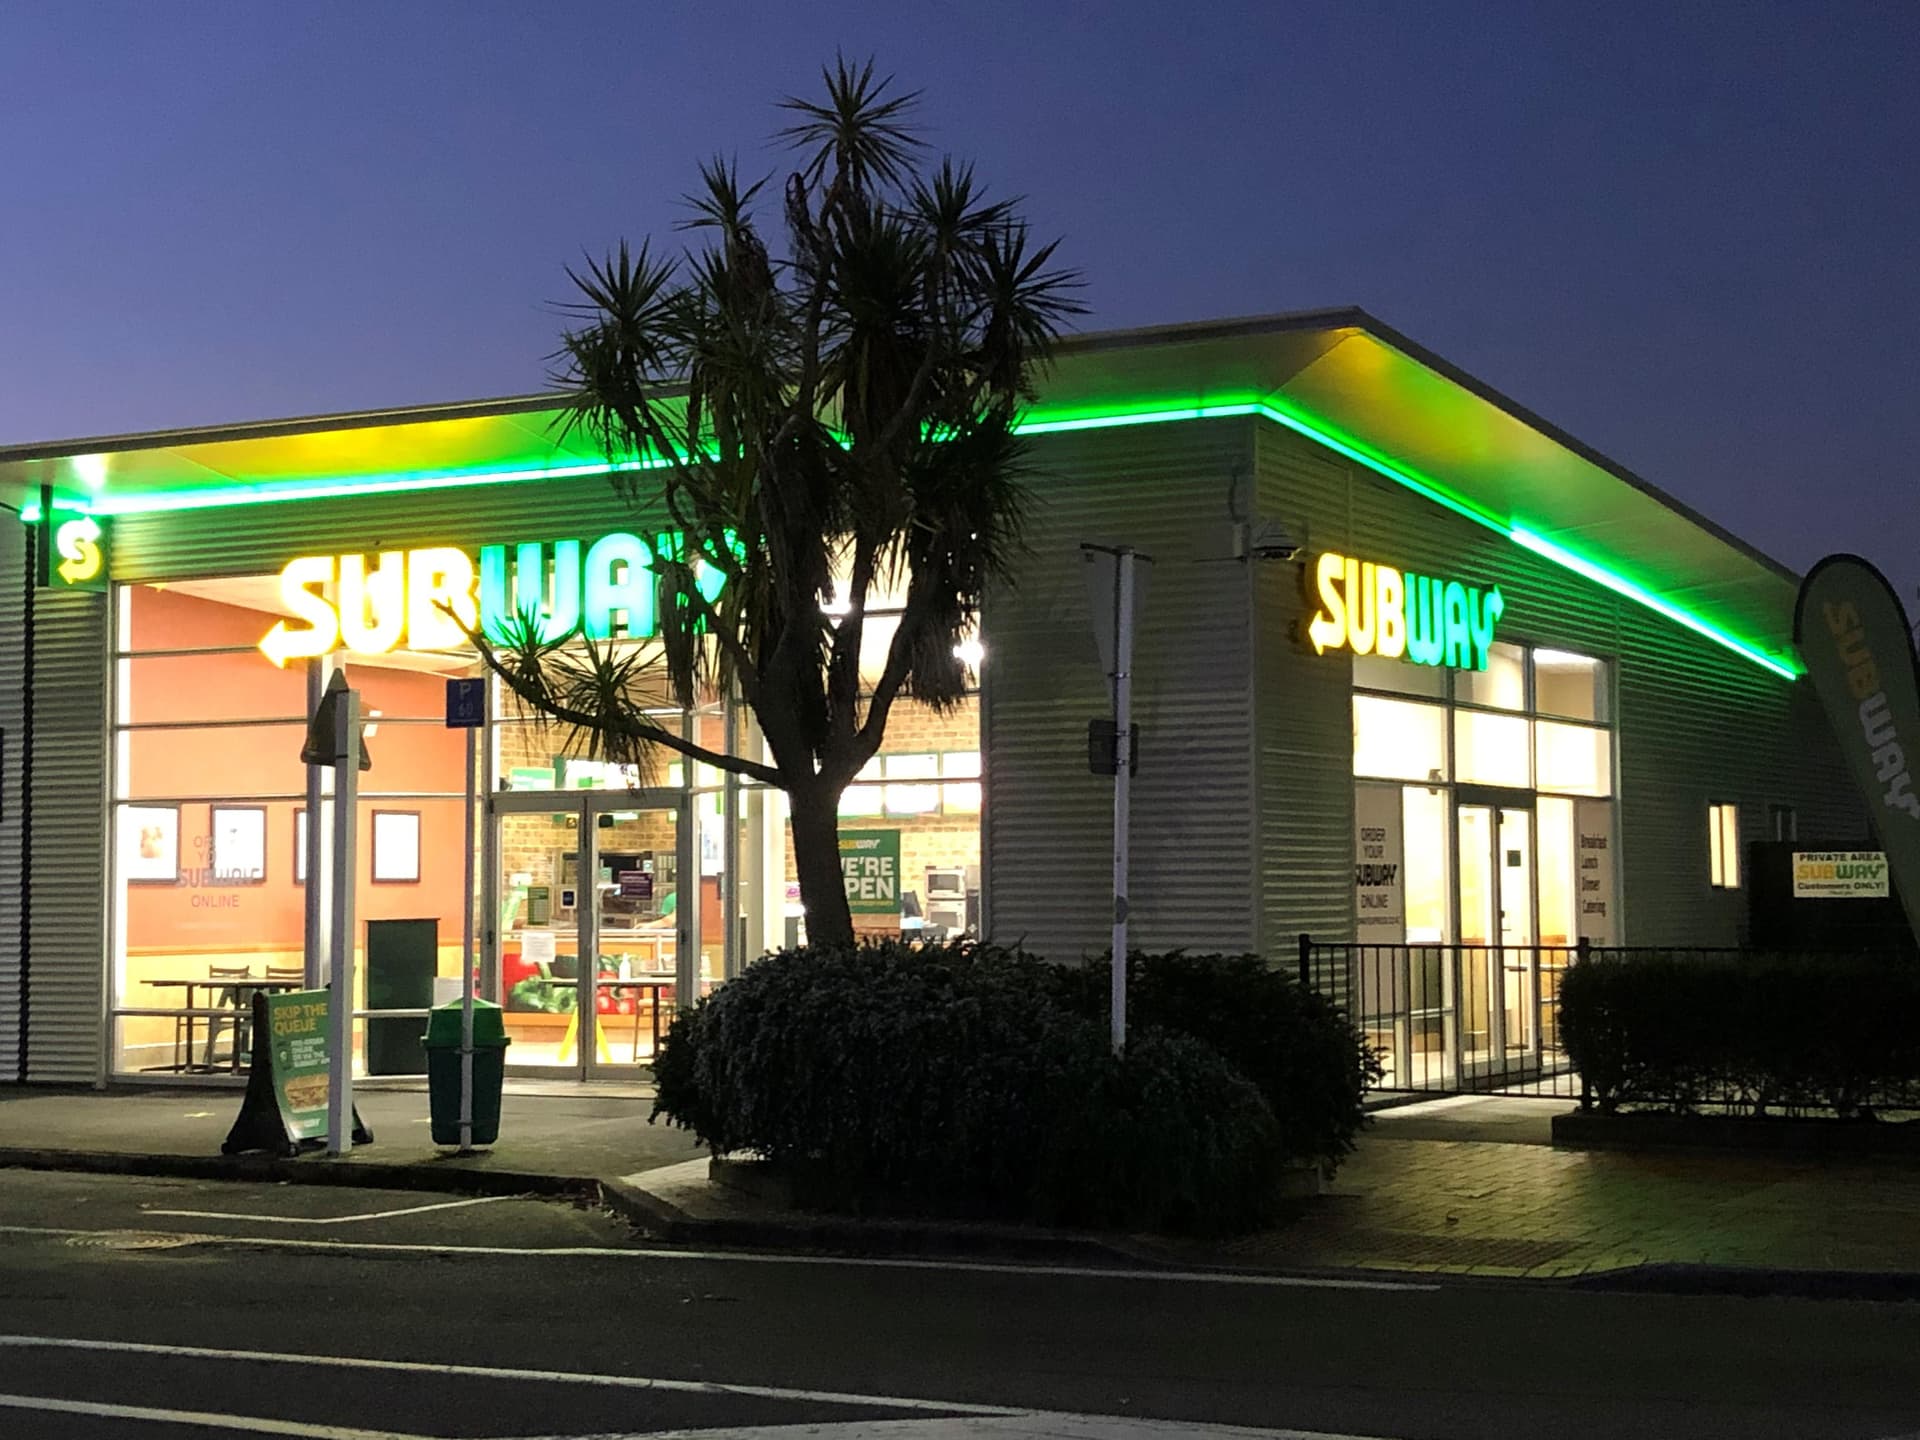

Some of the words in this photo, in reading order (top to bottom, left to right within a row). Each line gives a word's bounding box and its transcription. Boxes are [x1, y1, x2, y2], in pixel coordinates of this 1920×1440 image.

[1308, 551, 1504, 672] SUBWAY
[459, 682, 472, 700] P
[1823, 600, 1920, 820] SUBWAY
[1799, 853, 1847, 862] PRIVATE
[1797, 863, 1885, 879] SUBWAY
[843, 876, 894, 900] PEN
[191, 893, 240, 908] ONLINE
[273, 1005, 301, 1020] SKIP
[302, 1002, 328, 1017] THE
[274, 1018, 317, 1036] QUEUE
